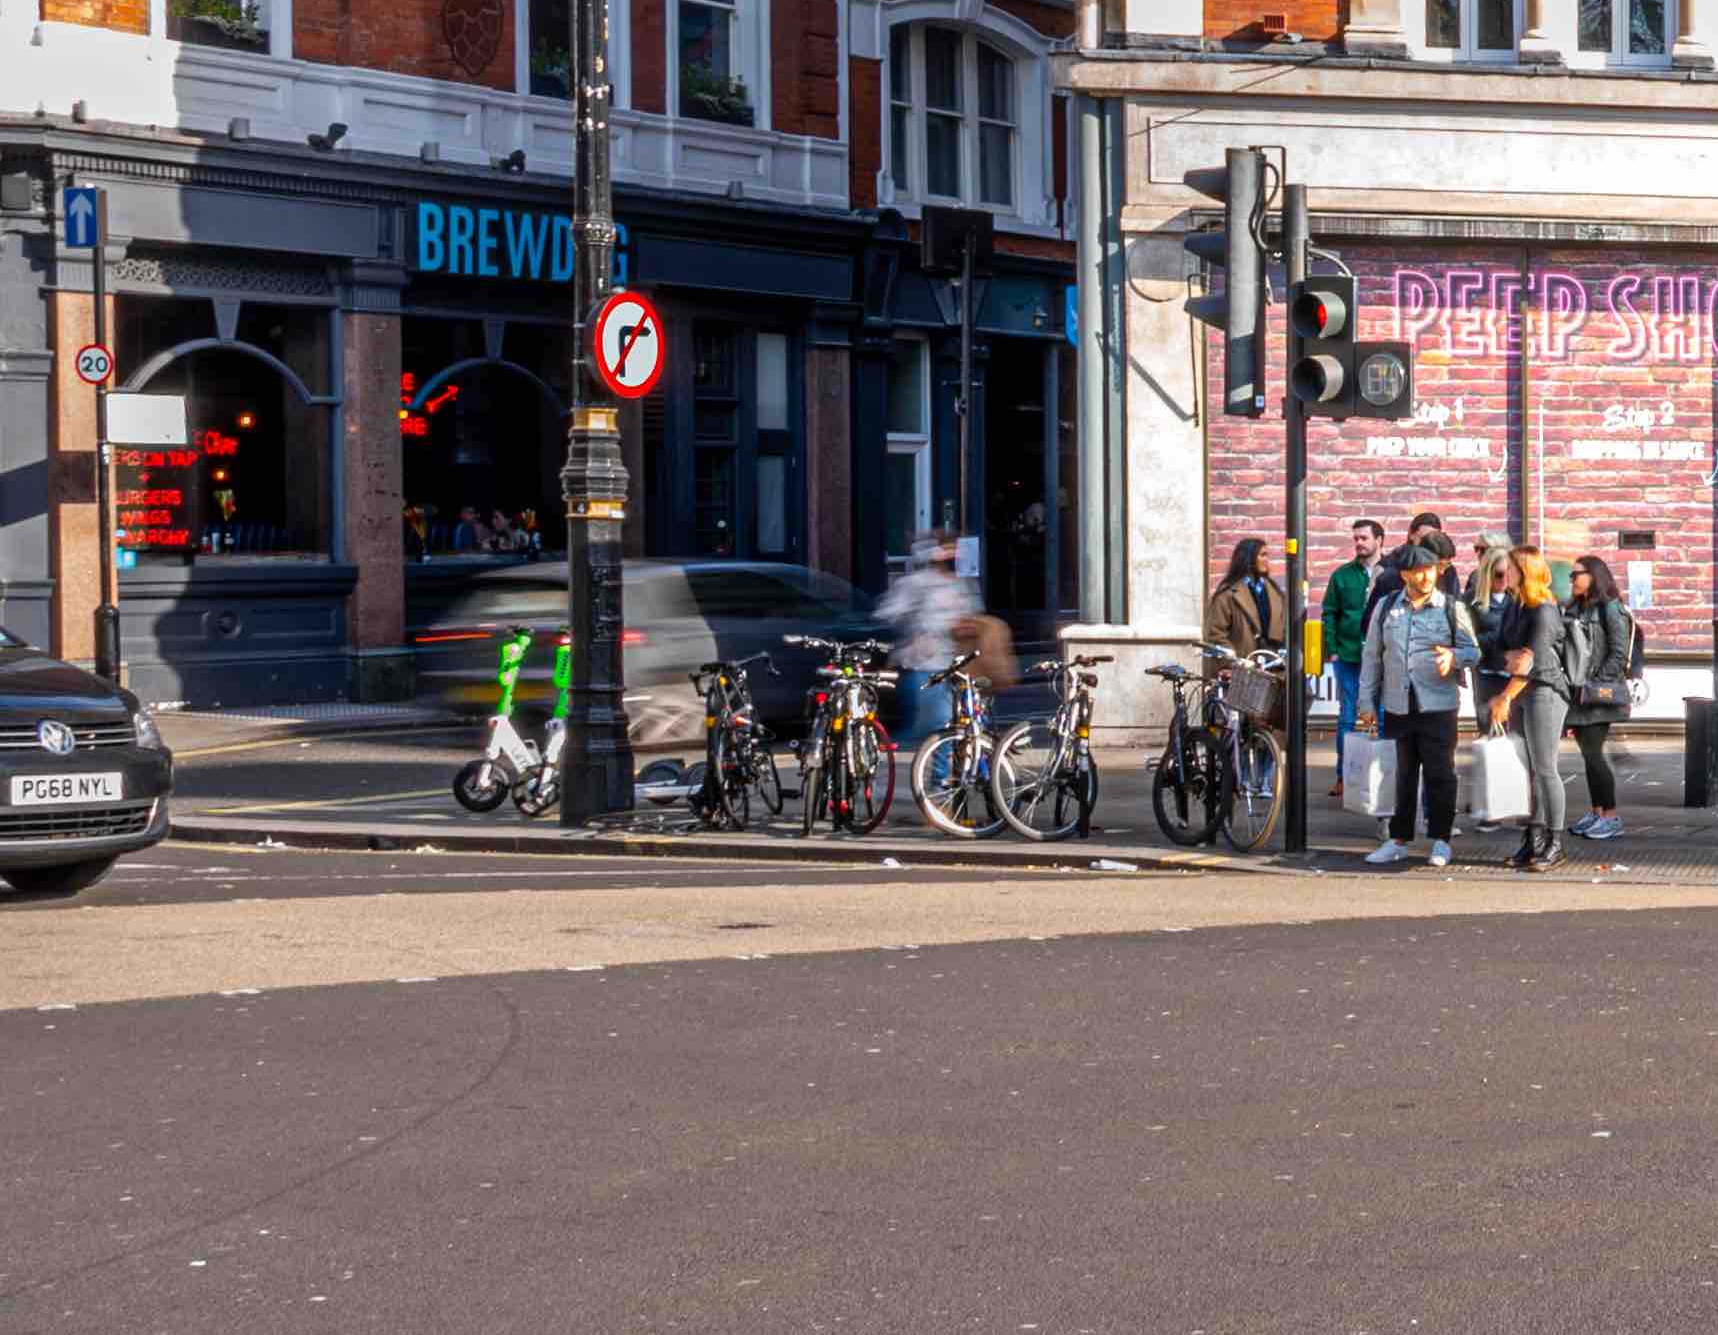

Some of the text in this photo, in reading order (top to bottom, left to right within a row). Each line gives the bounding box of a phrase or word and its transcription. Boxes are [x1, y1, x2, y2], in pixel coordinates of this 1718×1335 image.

[417, 201, 628, 286] BREWDG
[1394, 270, 1588, 360] PEEP
[81, 356, 108, 373] 20
[1602, 401, 1675, 434] Step 2
[22, 777, 112, 799] PG68 NYL
